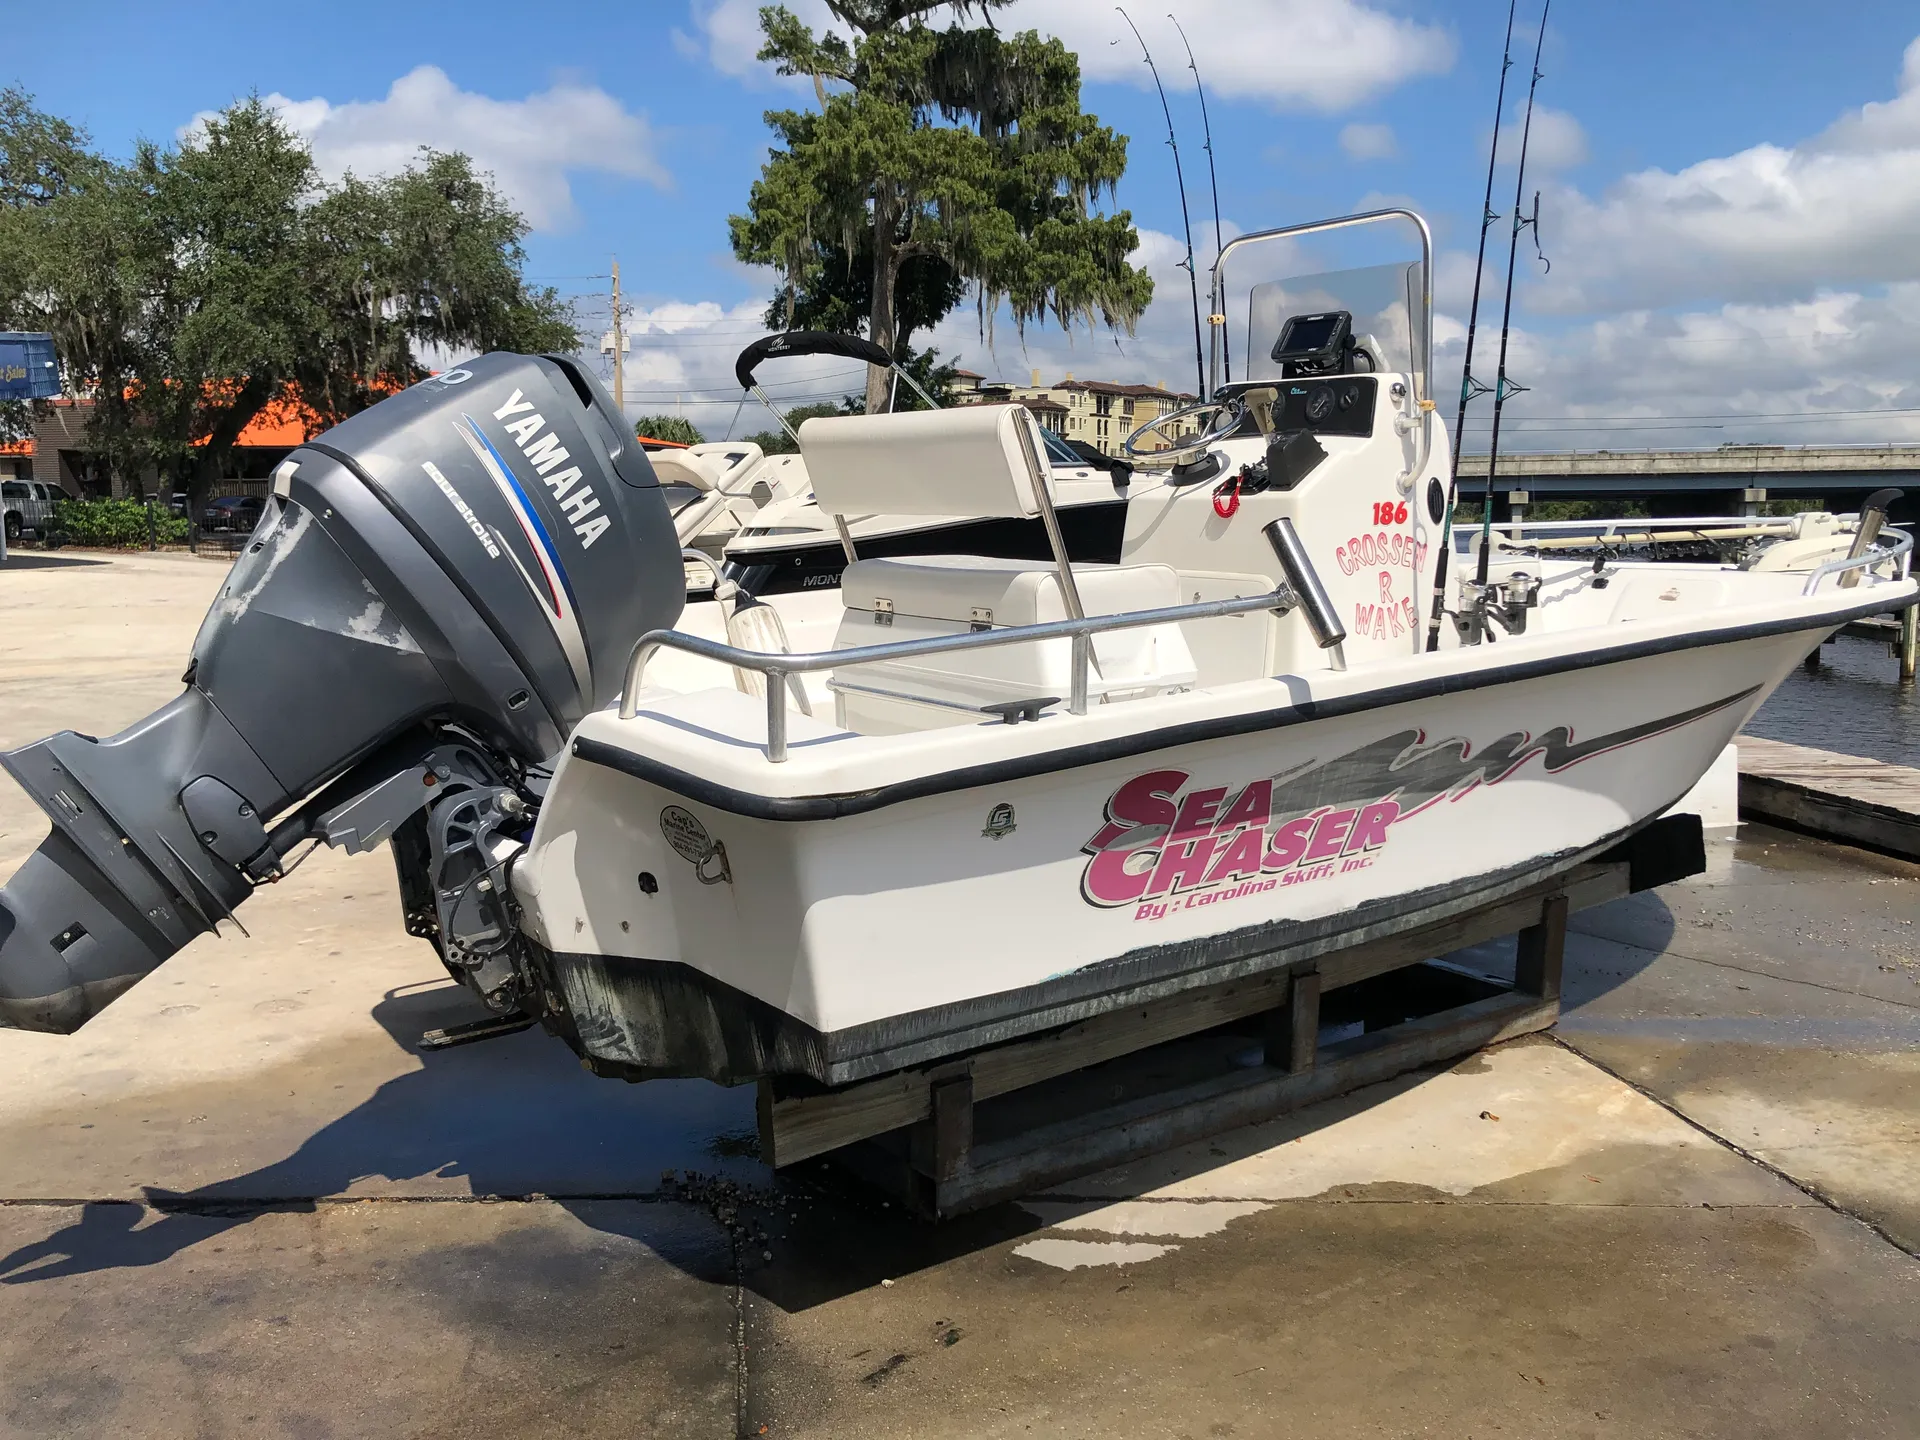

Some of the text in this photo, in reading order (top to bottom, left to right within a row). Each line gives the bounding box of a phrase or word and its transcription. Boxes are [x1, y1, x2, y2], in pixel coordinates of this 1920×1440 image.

[492, 388, 611, 550] YAMAHA
[1373, 501, 1408, 525] 186
[1336, 531, 1428, 577] CROSSEN
[1379, 571, 1394, 604] R
[1355, 597, 1419, 640] WAKE
[1082, 769, 1274, 850] SEA
[1080, 801, 1401, 908] CHASER
[1135, 903, 1168, 921] By
[1184, 878, 1277, 909] Carolina
[1279, 862, 1335, 888] Skiff,
[1339, 856, 1374, 874] Inc.
